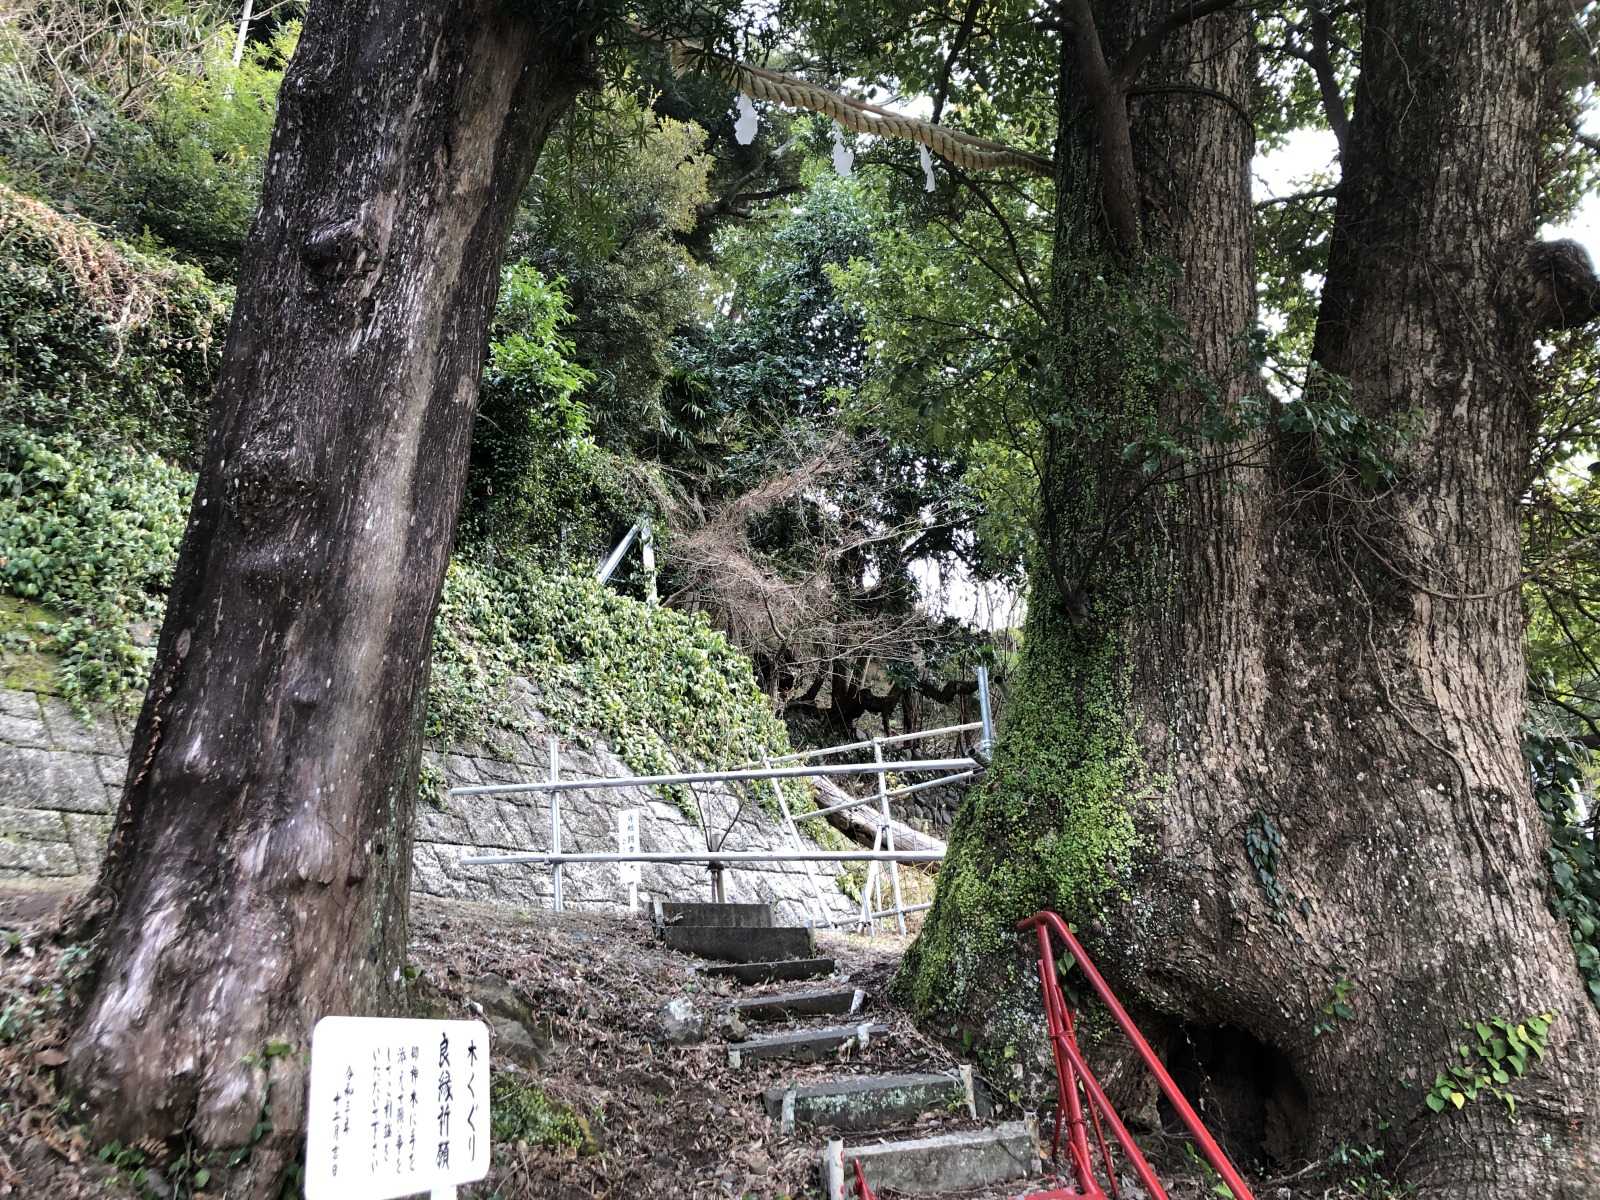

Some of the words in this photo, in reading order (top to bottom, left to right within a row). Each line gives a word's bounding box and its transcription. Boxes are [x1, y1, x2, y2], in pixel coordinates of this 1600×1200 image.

[436, 1032, 453, 1170] 良縁祈願
[467, 1040, 478, 1162] 木くぐり
